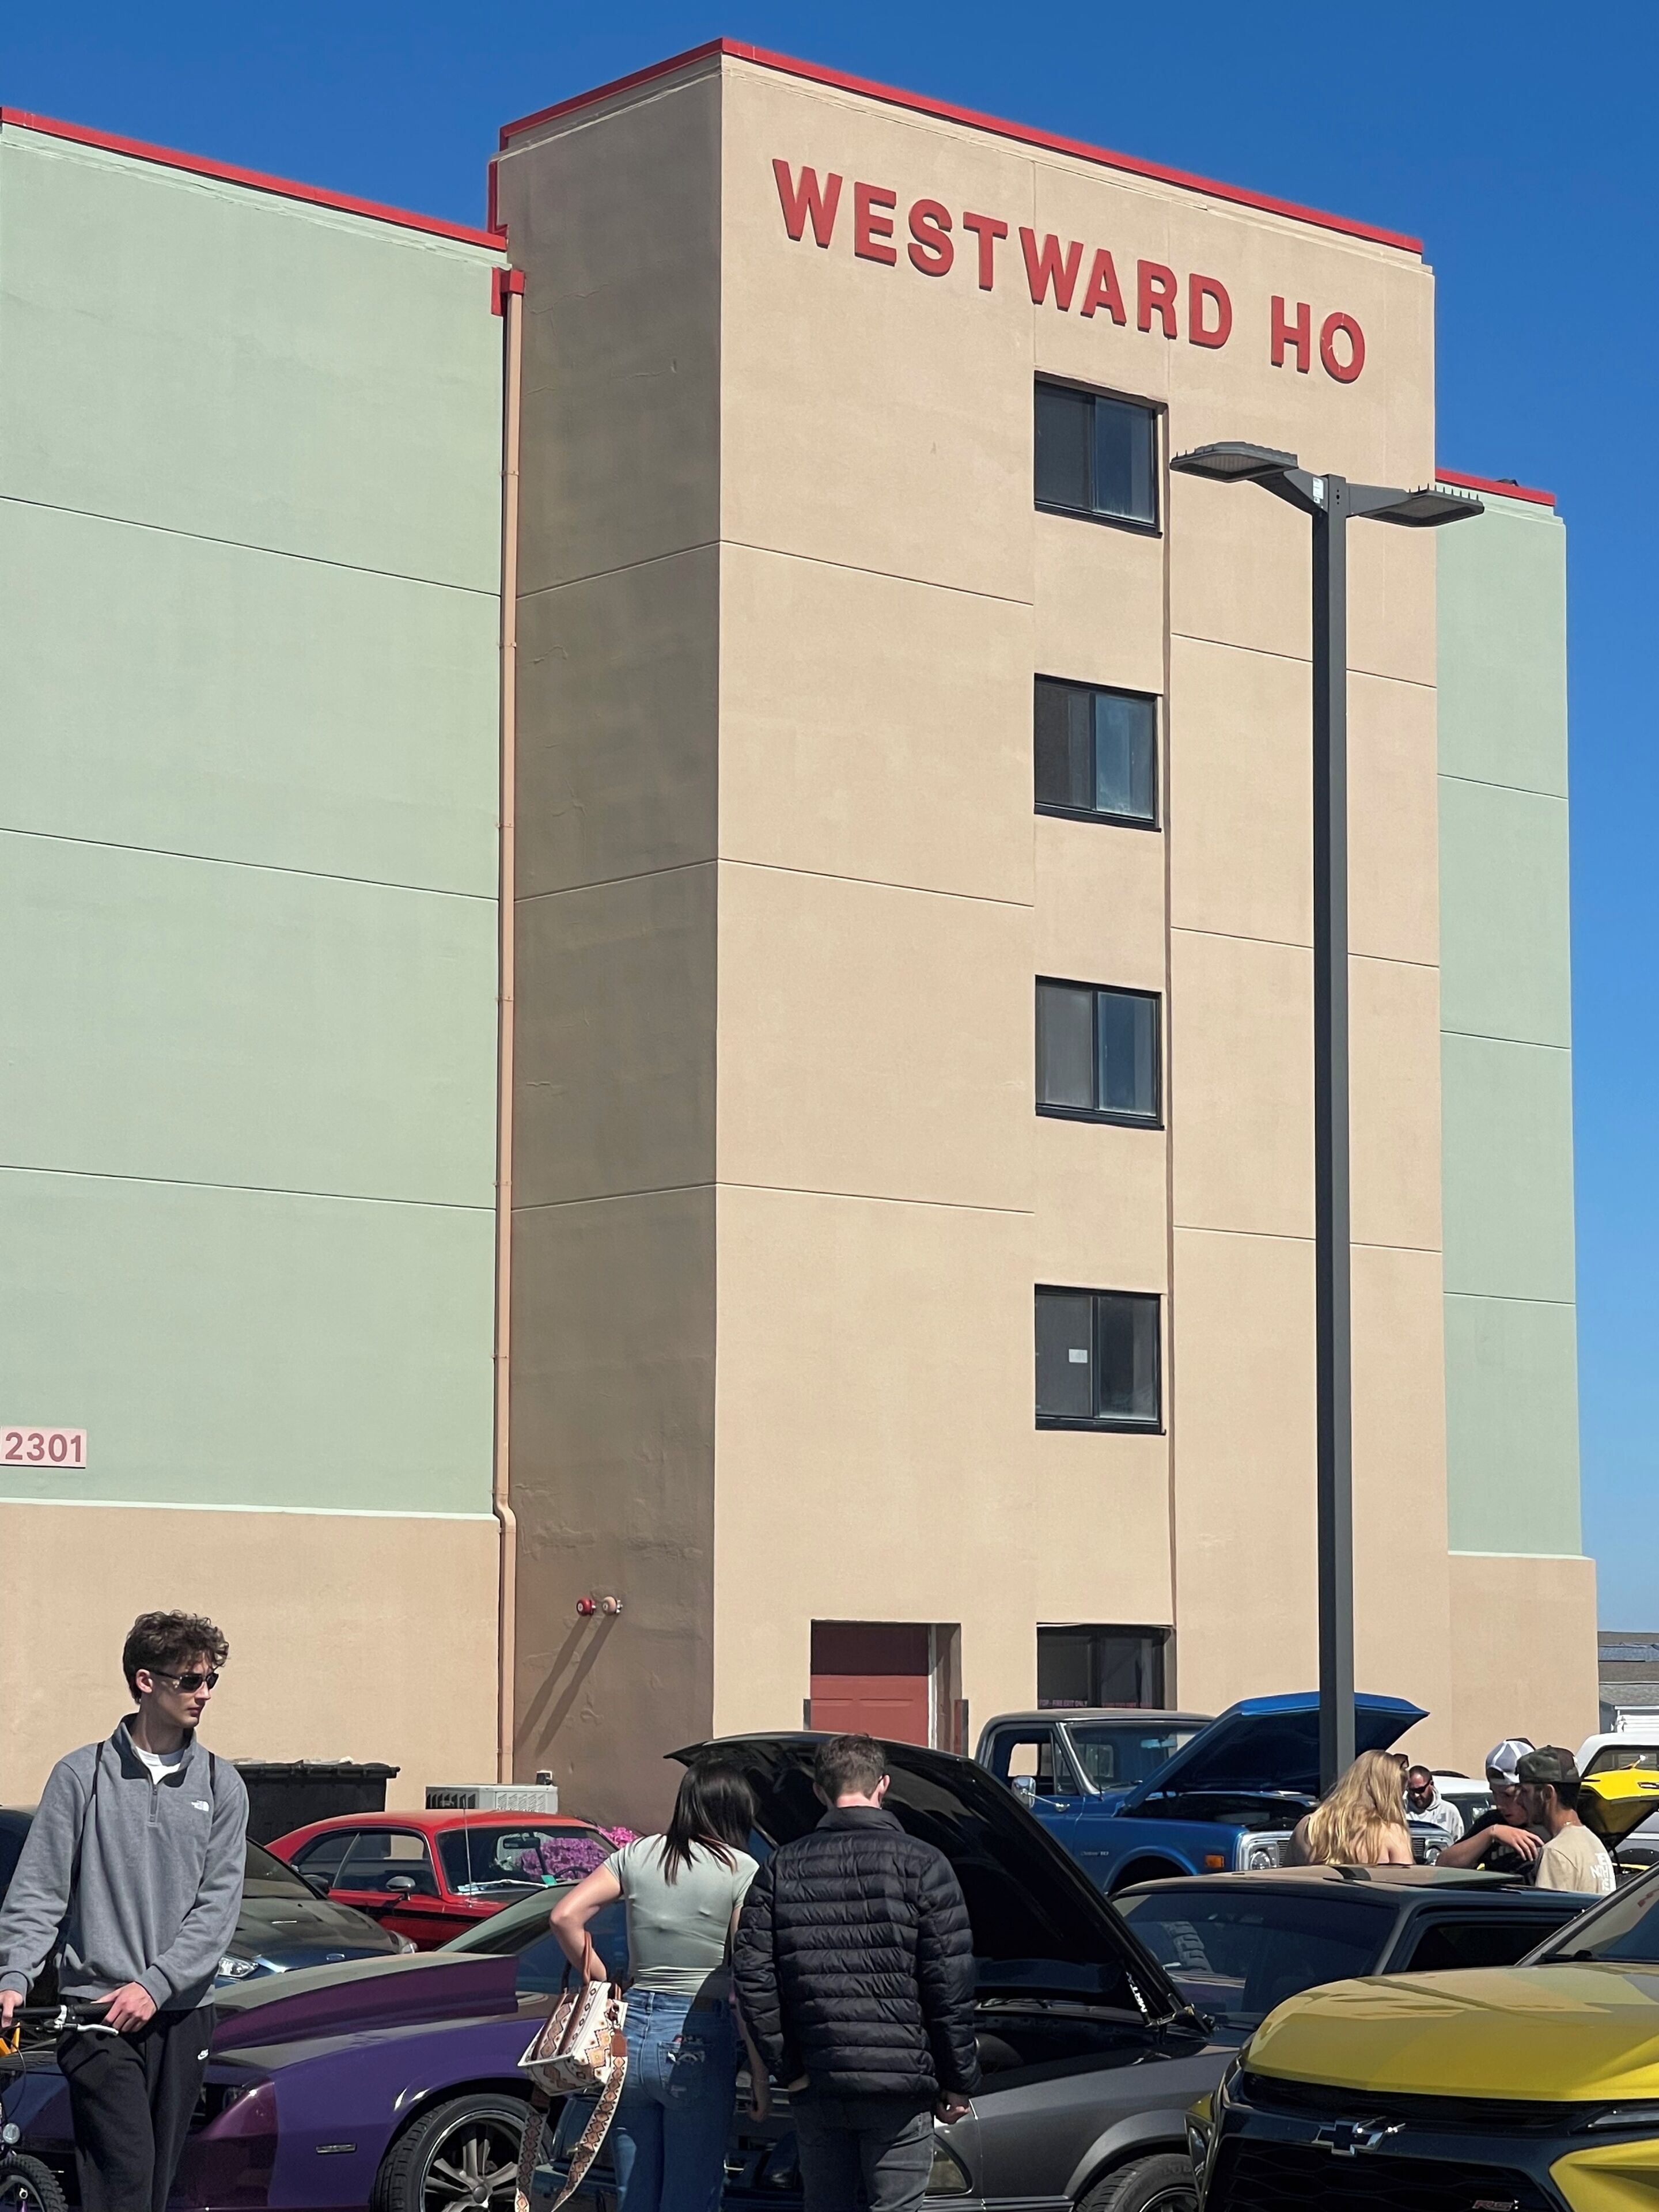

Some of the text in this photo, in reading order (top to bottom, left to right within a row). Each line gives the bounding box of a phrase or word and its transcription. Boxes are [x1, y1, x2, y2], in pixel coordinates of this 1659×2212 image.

[772, 158, 1365, 384] WESTWARD HO
[5, 1432, 81, 1462] 2301
[1472, 2200, 1514, 2211] RS
